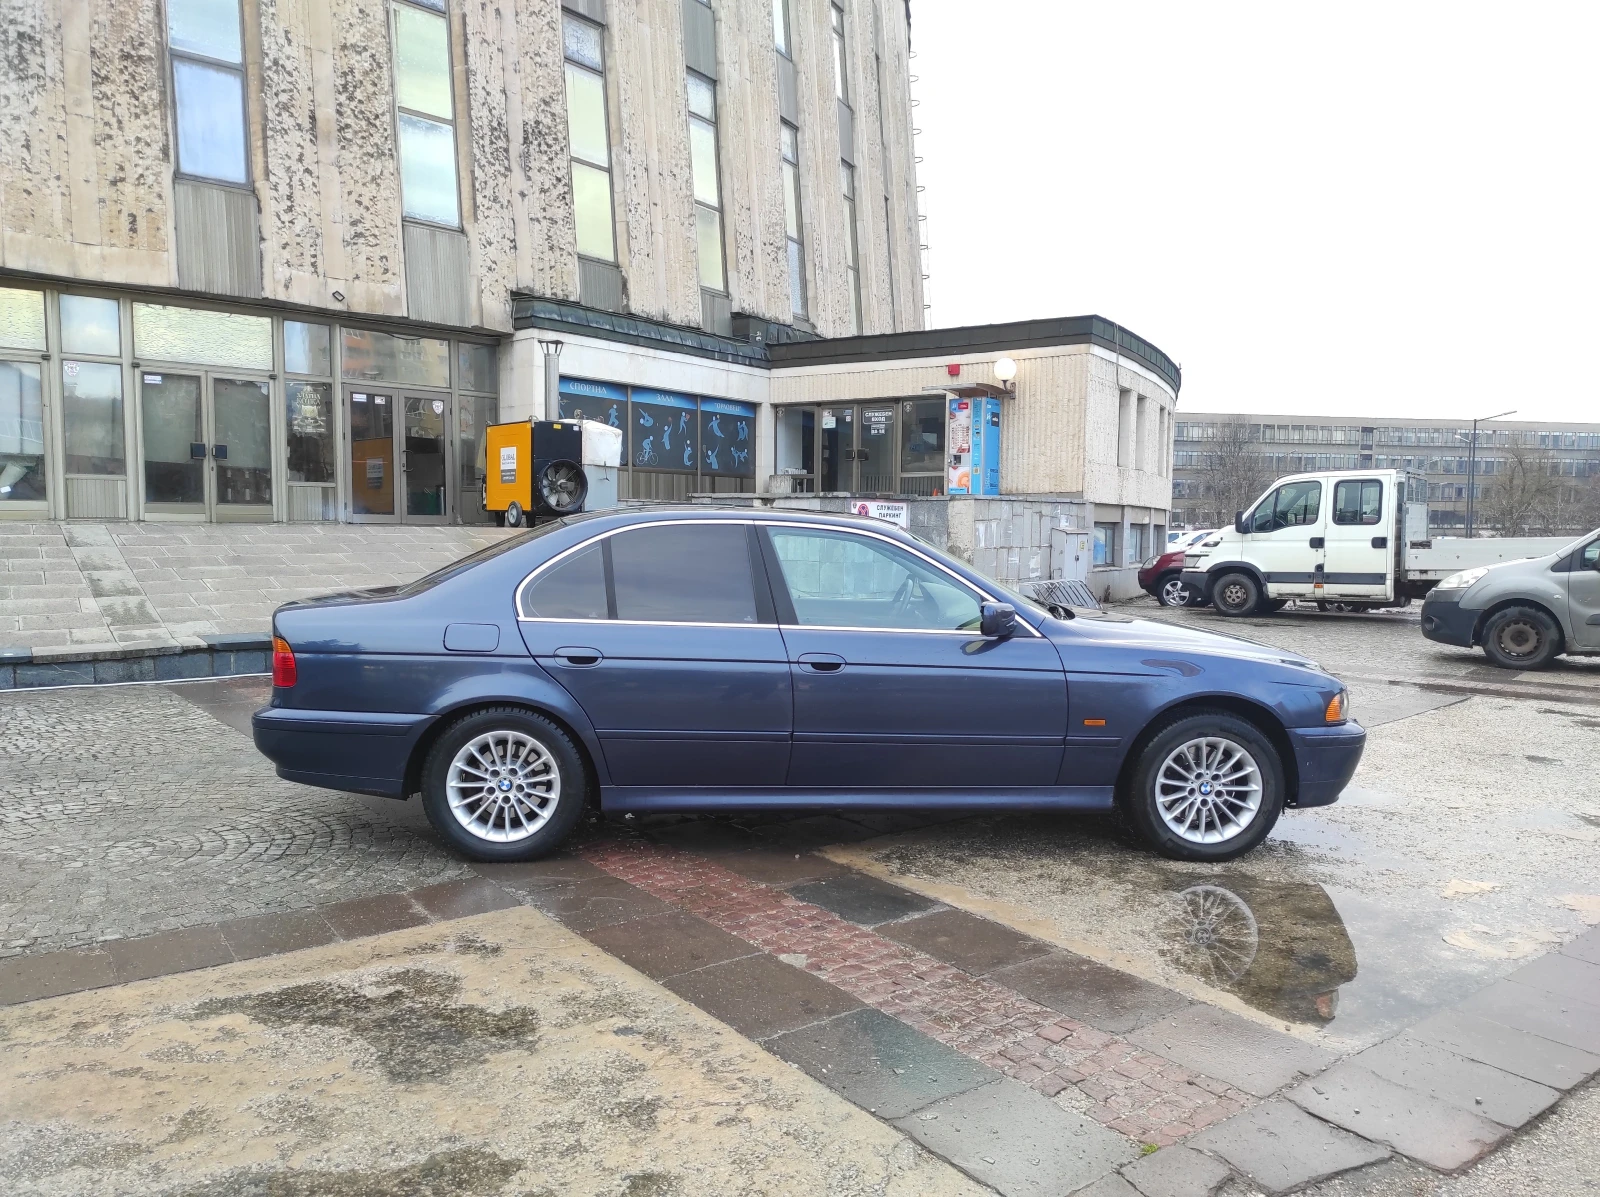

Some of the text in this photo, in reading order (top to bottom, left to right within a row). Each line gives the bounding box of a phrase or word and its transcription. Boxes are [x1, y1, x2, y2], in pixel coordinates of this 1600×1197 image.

[569, 381, 607, 395] СПОРТНА
[656, 393, 675, 403] ЗАЛА
[876, 504, 904, 512] СЛУЖЕБЕН
